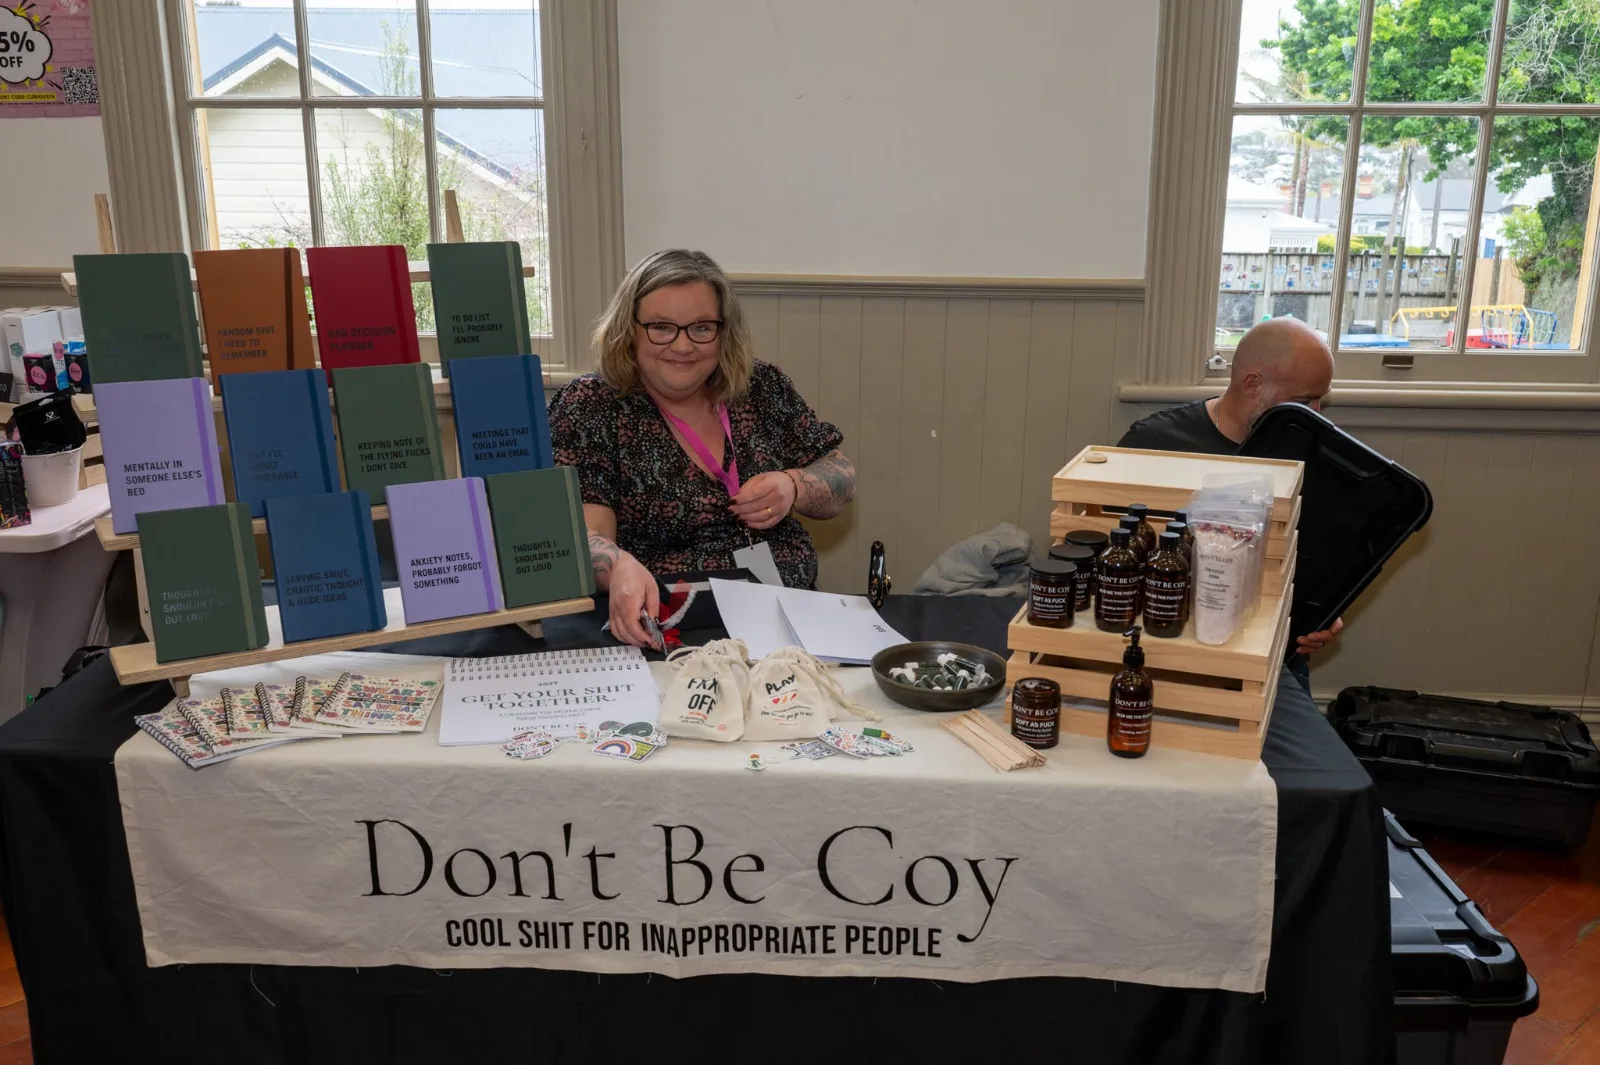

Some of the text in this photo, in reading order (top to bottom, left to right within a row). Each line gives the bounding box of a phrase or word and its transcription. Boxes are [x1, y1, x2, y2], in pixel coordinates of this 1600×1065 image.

[0, 56, 23, 68] OFF
[463, 314, 473, 322] DO
[475, 313, 490, 321] LIST
[217, 326, 275, 336] RANDOM SHIT
[328, 326, 396, 339] BAD DECISION
[467, 323, 503, 332] PROBABLY
[248, 338, 260, 347] TO
[454, 335, 480, 344] IGNORE
[330, 341, 374, 353] PLANNER
[220, 349, 268, 360] REMEMBER
[472, 427, 530, 439] MEETINGS THAT
[358, 437, 425, 451] KEEPING NOTE OF
[473, 438, 519, 450] COULD HAVE
[360, 448, 431, 462] THE FLYING FUCKS
[474, 449, 531, 461] BEEN AN EMAIL
[123, 459, 183, 473] MENTALLY IN
[389, 460, 408, 470] GIVE
[125, 469, 202, 485] SOMEONE ELSE'S
[127, 488, 146, 497] BED
[512, 542, 552, 553] THOUGHTS
[410, 552, 474, 568] ANXIETY NOTES,
[515, 549, 570, 564] SHOULDN'T SAY
[412, 562, 482, 579] PROBABLY FORGOT
[516, 562, 552, 575] OUT LOUD
[284, 572, 321, 584] SERVING
[413, 576, 460, 590] SOMETHING
[1098, 574, 1119, 584] DON'T
[1145, 578, 1186, 589] DON'T BE COY
[286, 584, 323, 597] CHAOTIC
[1030, 583, 1047, 593] DON'T
[288, 598, 295, 608] &
[322, 592, 348, 603] IDEAS
[1032, 595, 1044, 603] SOFT
[163, 598, 214, 613] SHOULDN'T
[165, 611, 211, 625] OUT LOUD
[350, 683, 429, 697] SWEARY
[765, 674, 796, 695] PLAY
[461, 683, 635, 704] GET YOUR SHIT
[342, 701, 374, 709] SAY
[375, 703, 421, 713] WHAT
[483, 694, 616, 711] TOGETHER.
[688, 693, 717, 715] OFF
[1115, 698, 1139, 708] DON'T
[1013, 703, 1033, 715] DON'T
[1015, 717, 1030, 727] SOFT
[353, 818, 1019, 944] Don't Be Coy
[444, 919, 943, 959] COOL SHIT FOR INAPPROPRIATE PEOPLE
